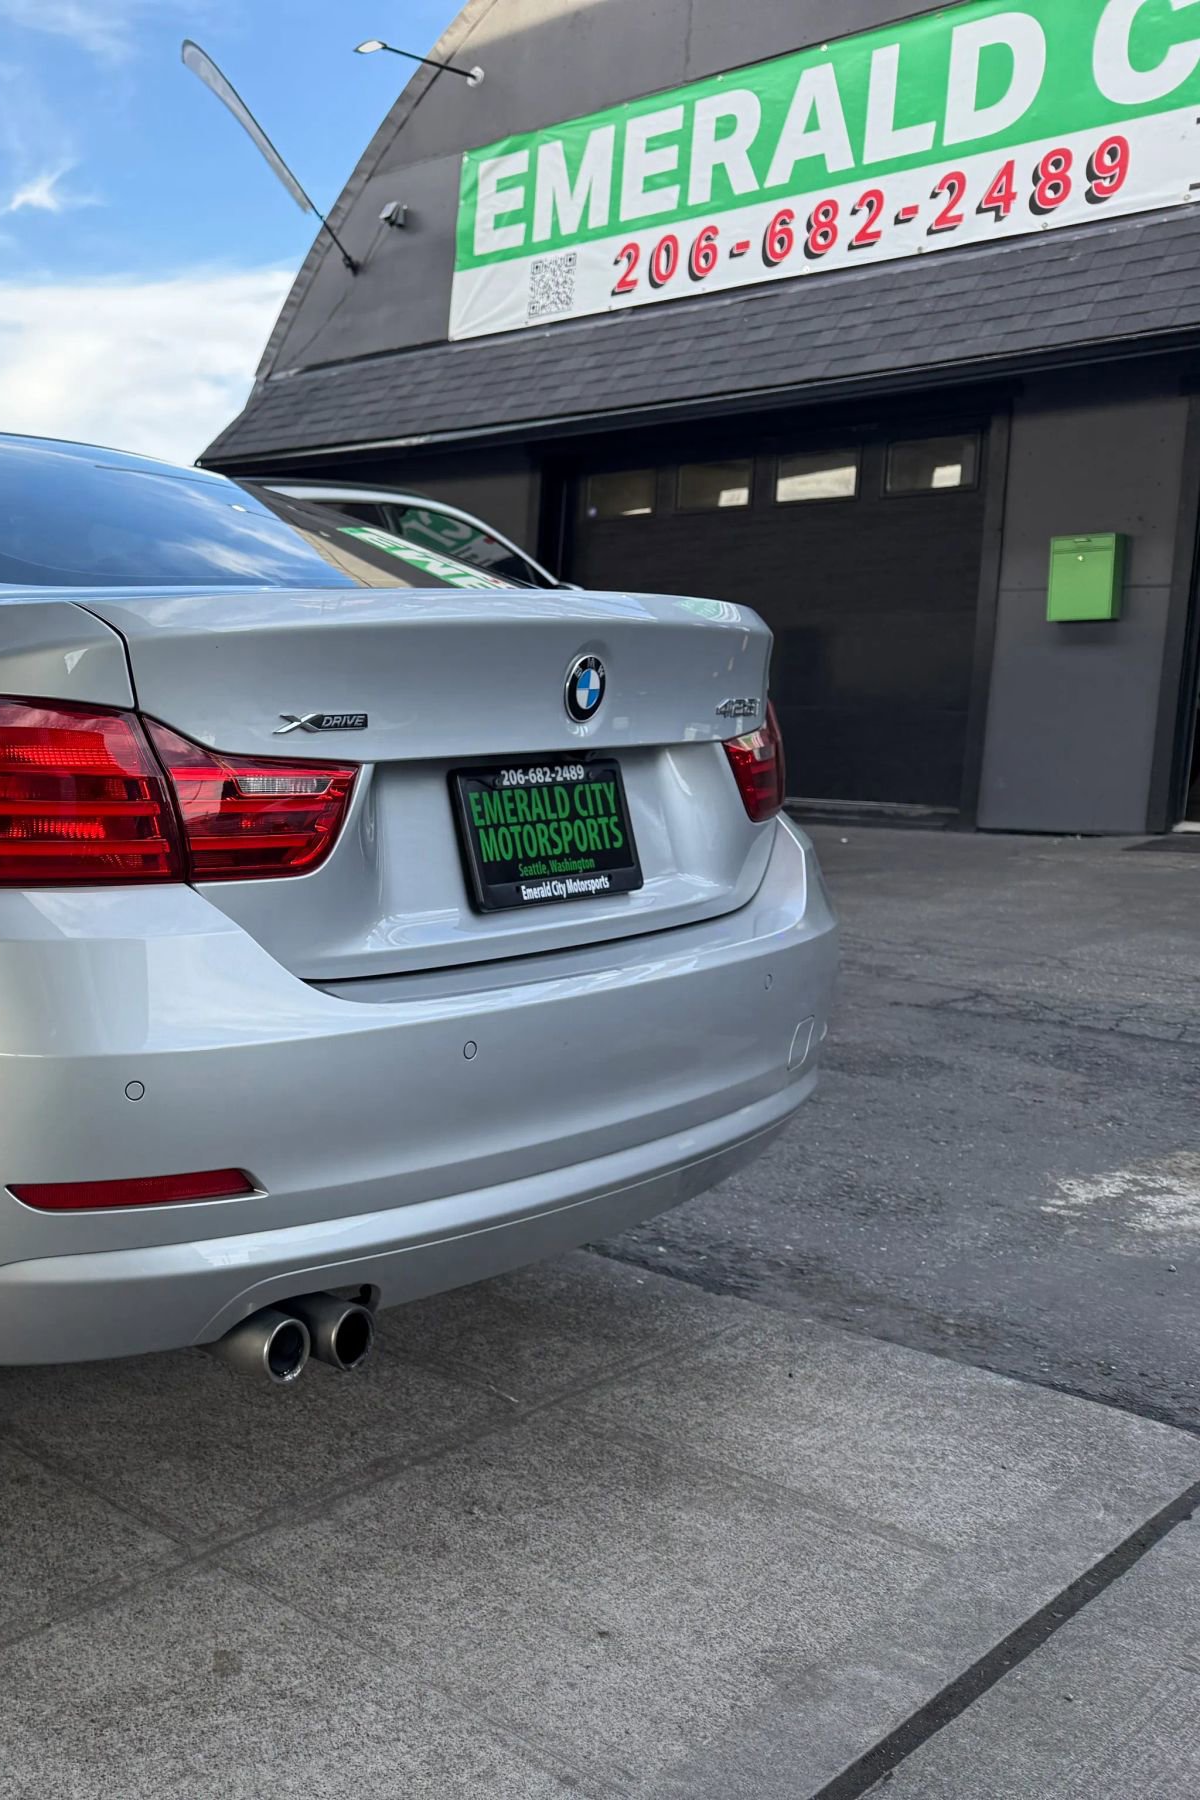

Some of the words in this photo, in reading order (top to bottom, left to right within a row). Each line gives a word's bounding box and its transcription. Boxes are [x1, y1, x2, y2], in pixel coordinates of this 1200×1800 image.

[473, 11, 1046, 256] EMERALD
[610, 134, 1130, 297] 206-682-2489
[500, 765, 585, 786] 206-682-2489
[468, 786, 570, 827] EMERALD
[574, 782, 617, 817] CITY
[478, 815, 623, 863] MOTORSPORTS
[519, 861, 550, 877] Seattle,
[549, 857, 596, 873] Washington
[521, 881, 552, 901] Emerald
[552, 880, 567, 898] City
[567, 875, 610, 894] Motorsports
